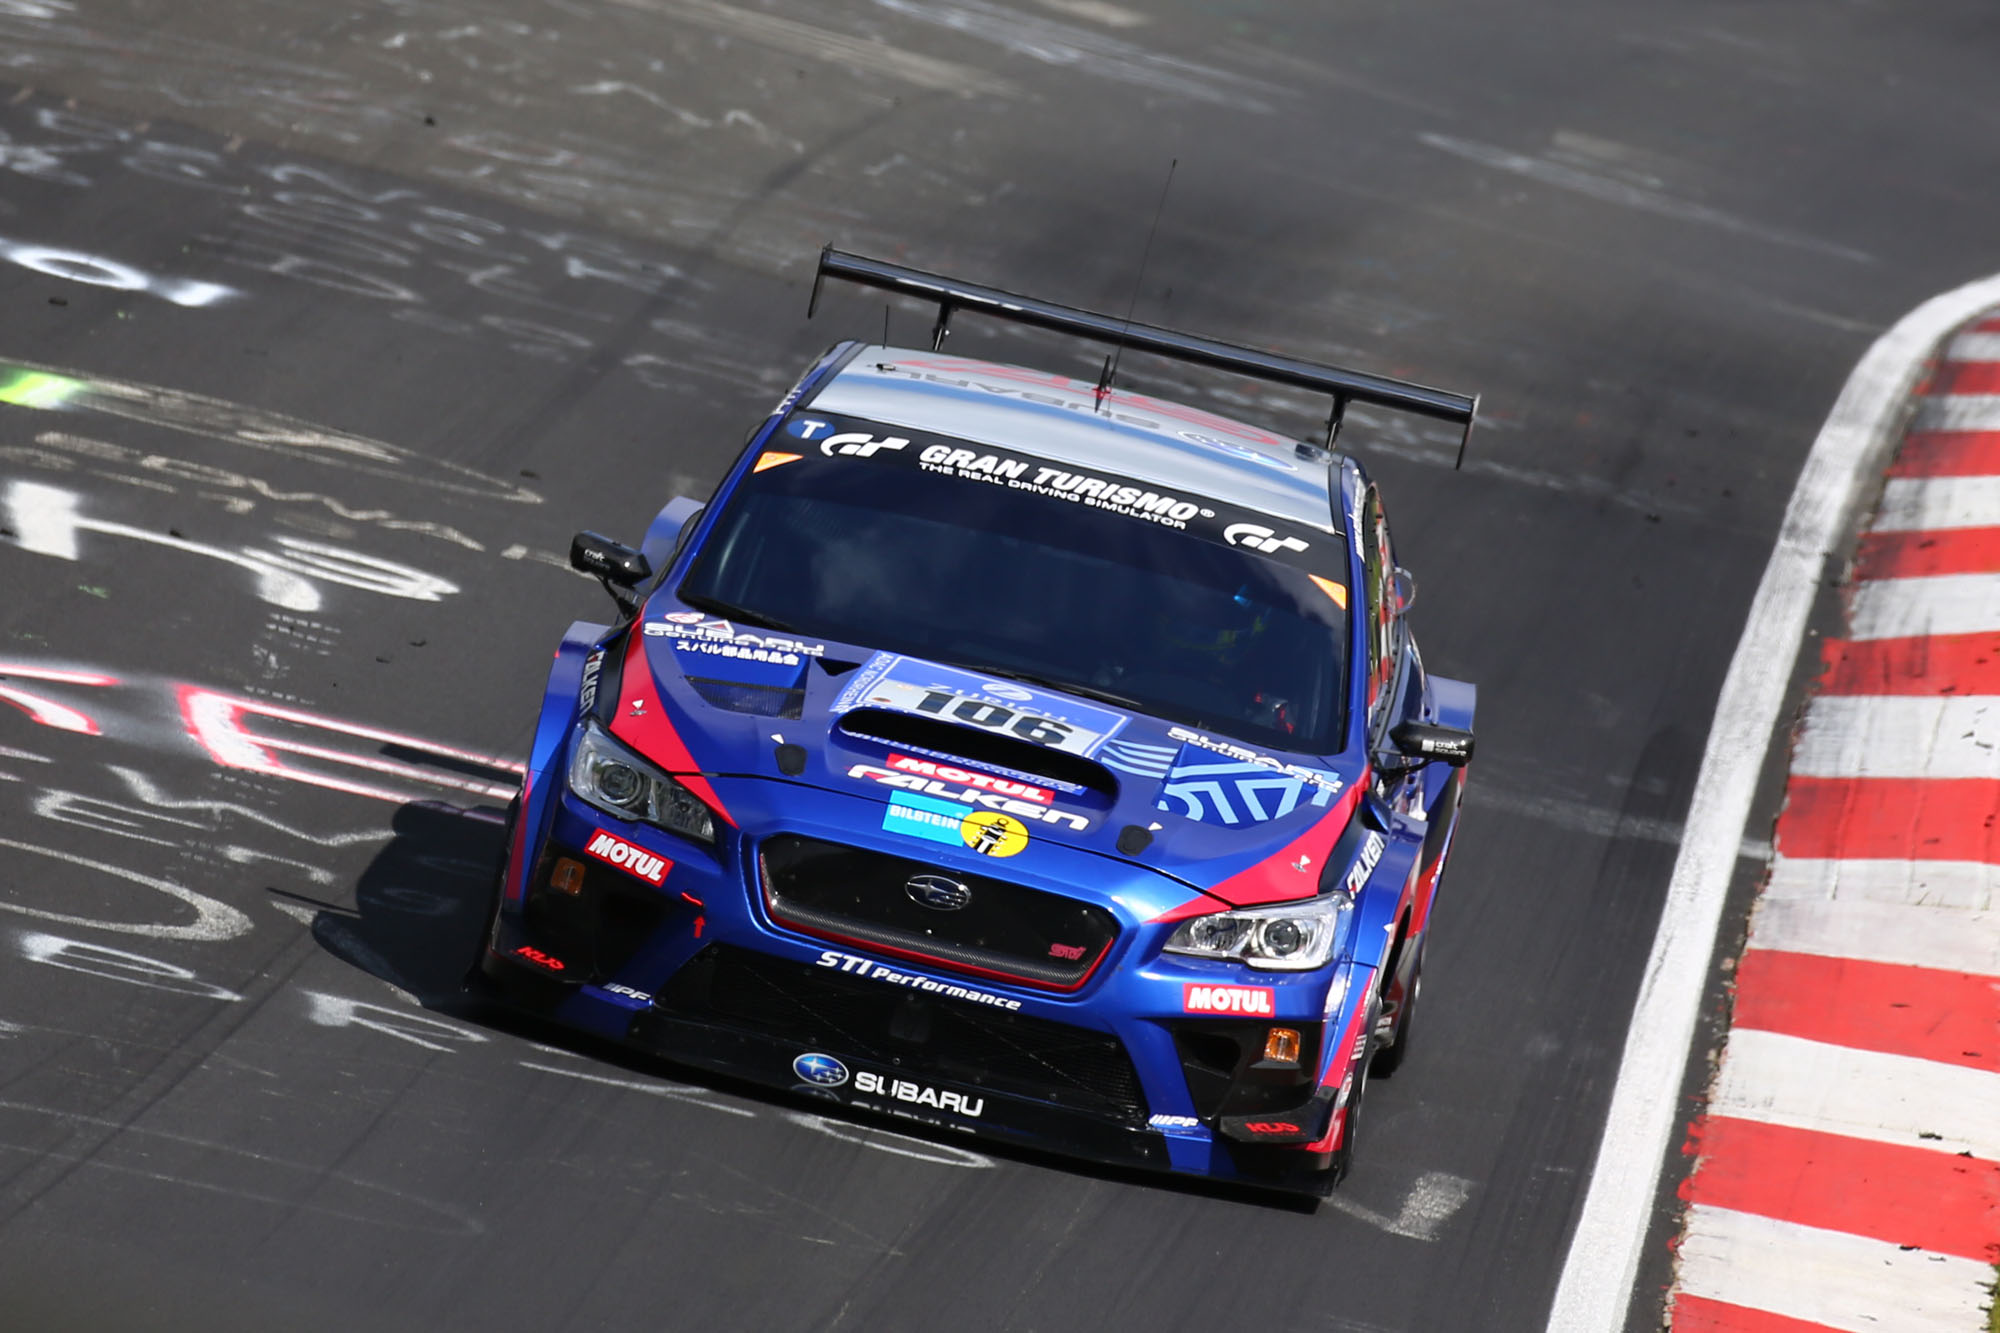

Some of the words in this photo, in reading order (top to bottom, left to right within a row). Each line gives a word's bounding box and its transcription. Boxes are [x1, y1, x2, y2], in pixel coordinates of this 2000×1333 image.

[801, 420, 826, 439] T
[919, 444, 1030, 478] GRAN
[919, 461, 955, 475] THE
[958, 469, 1004, 486] REAL
[1008, 480, 1081, 503] DRIVING
[1083, 497, 1188, 530] SIMULATOR
[579, 649, 606, 718] FALKEN
[914, 690, 1074, 745] 106
[847, 764, 1090, 832] FALKEN
[894, 757, 1046, 801] MOTUL
[889, 804, 962, 830] BILSTEIN
[587, 834, 666, 882] MOTUL
[1346, 829, 1386, 899] FALKEN
[816, 951, 874, 976] STI
[872, 966, 1022, 1012] Performance
[1188, 986, 1271, 1013] MOTUL
[854, 1071, 984, 1117] SUBARU
